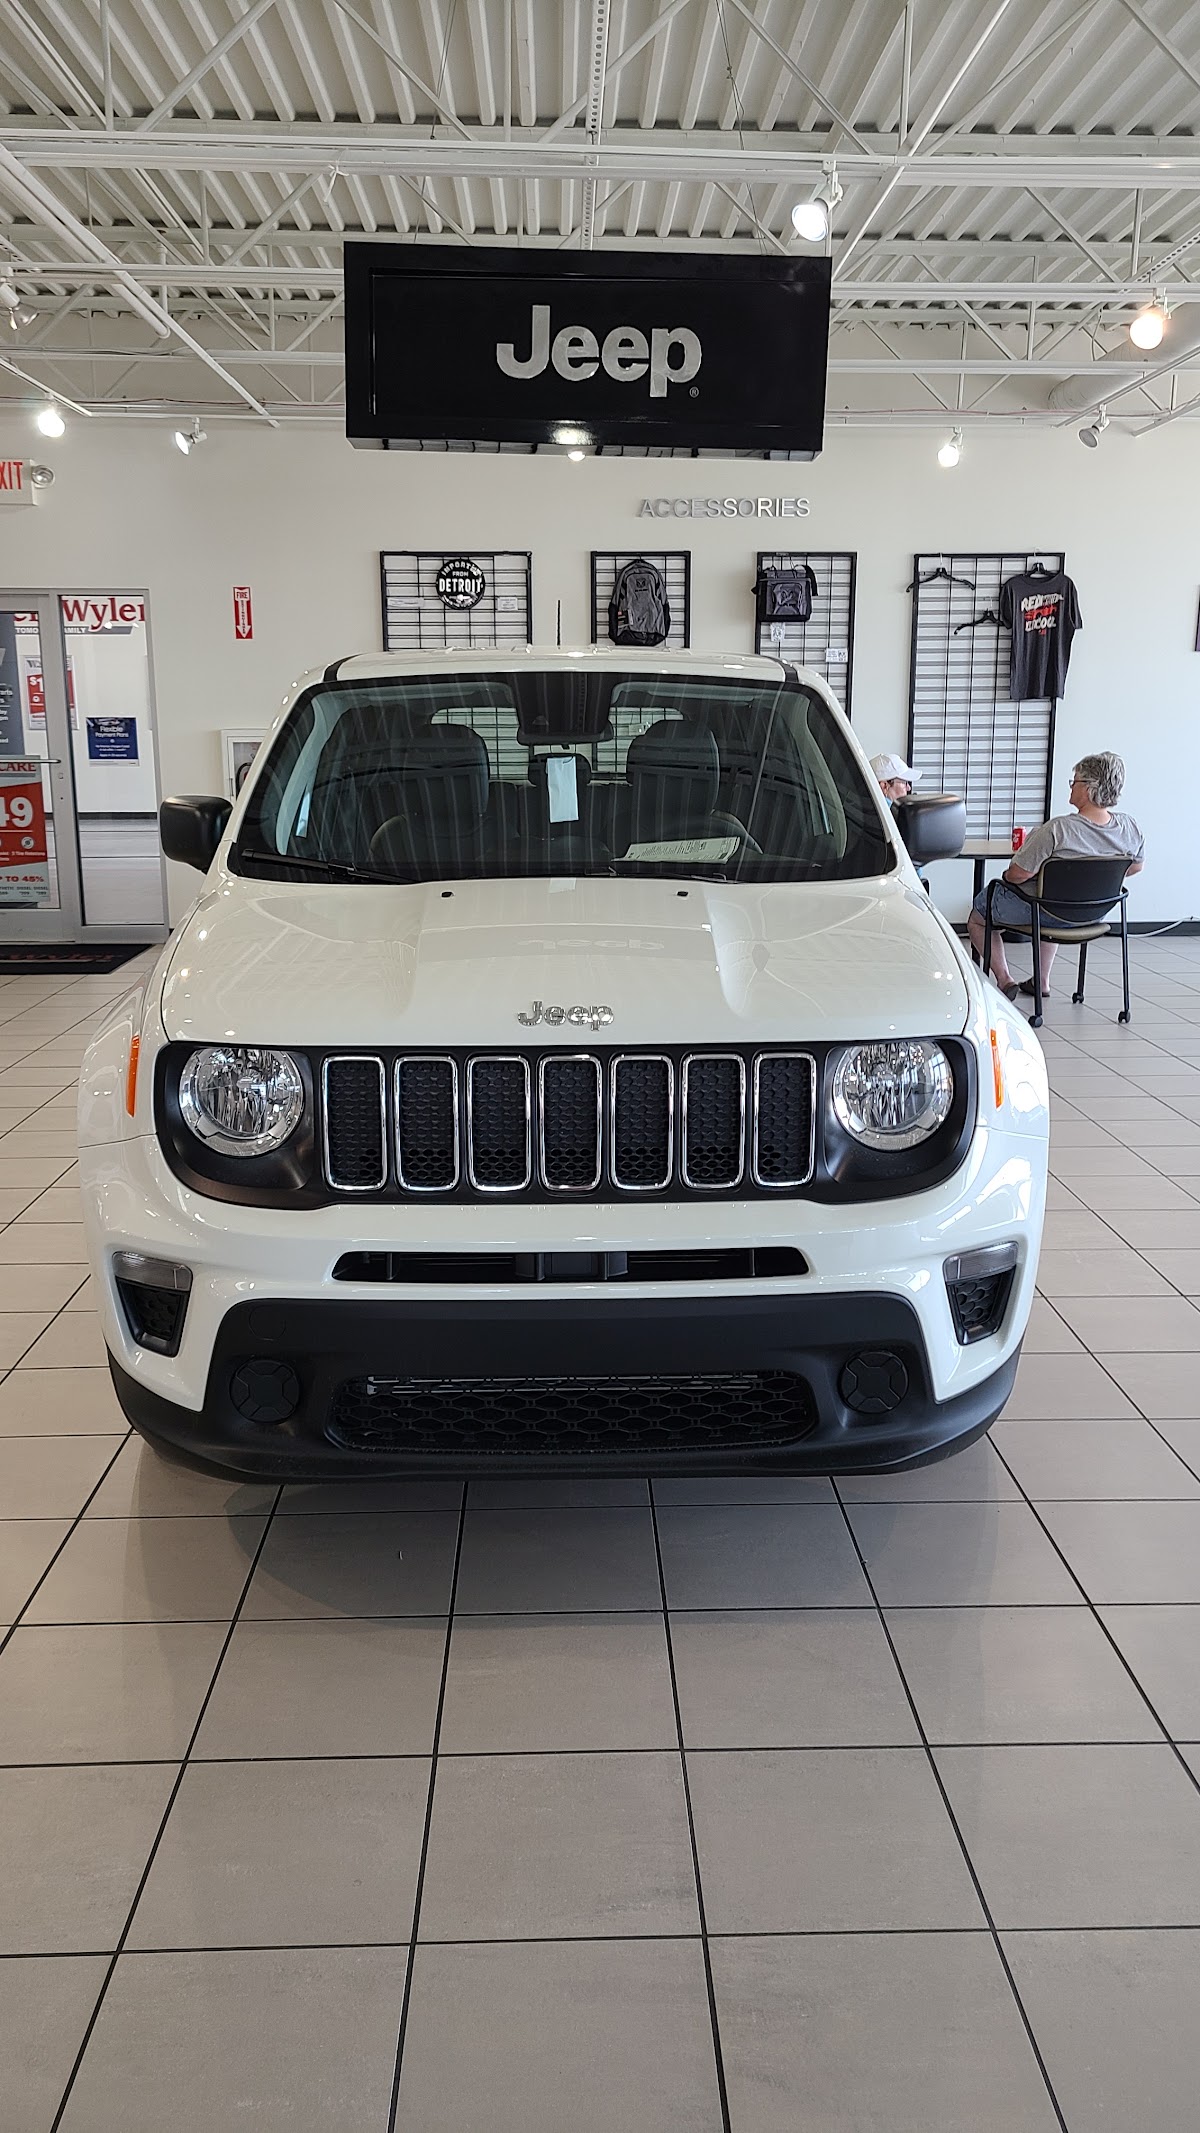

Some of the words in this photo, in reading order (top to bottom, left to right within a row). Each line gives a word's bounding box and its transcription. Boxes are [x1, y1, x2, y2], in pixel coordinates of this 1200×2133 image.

[496, 304, 702, 397] Jeep
[637, 497, 811, 518] ACCESSORIES
[439, 578, 482, 593] DETROIT
[0, 762, 36, 772] ARE
[517, 1001, 614, 1031] Jeep
